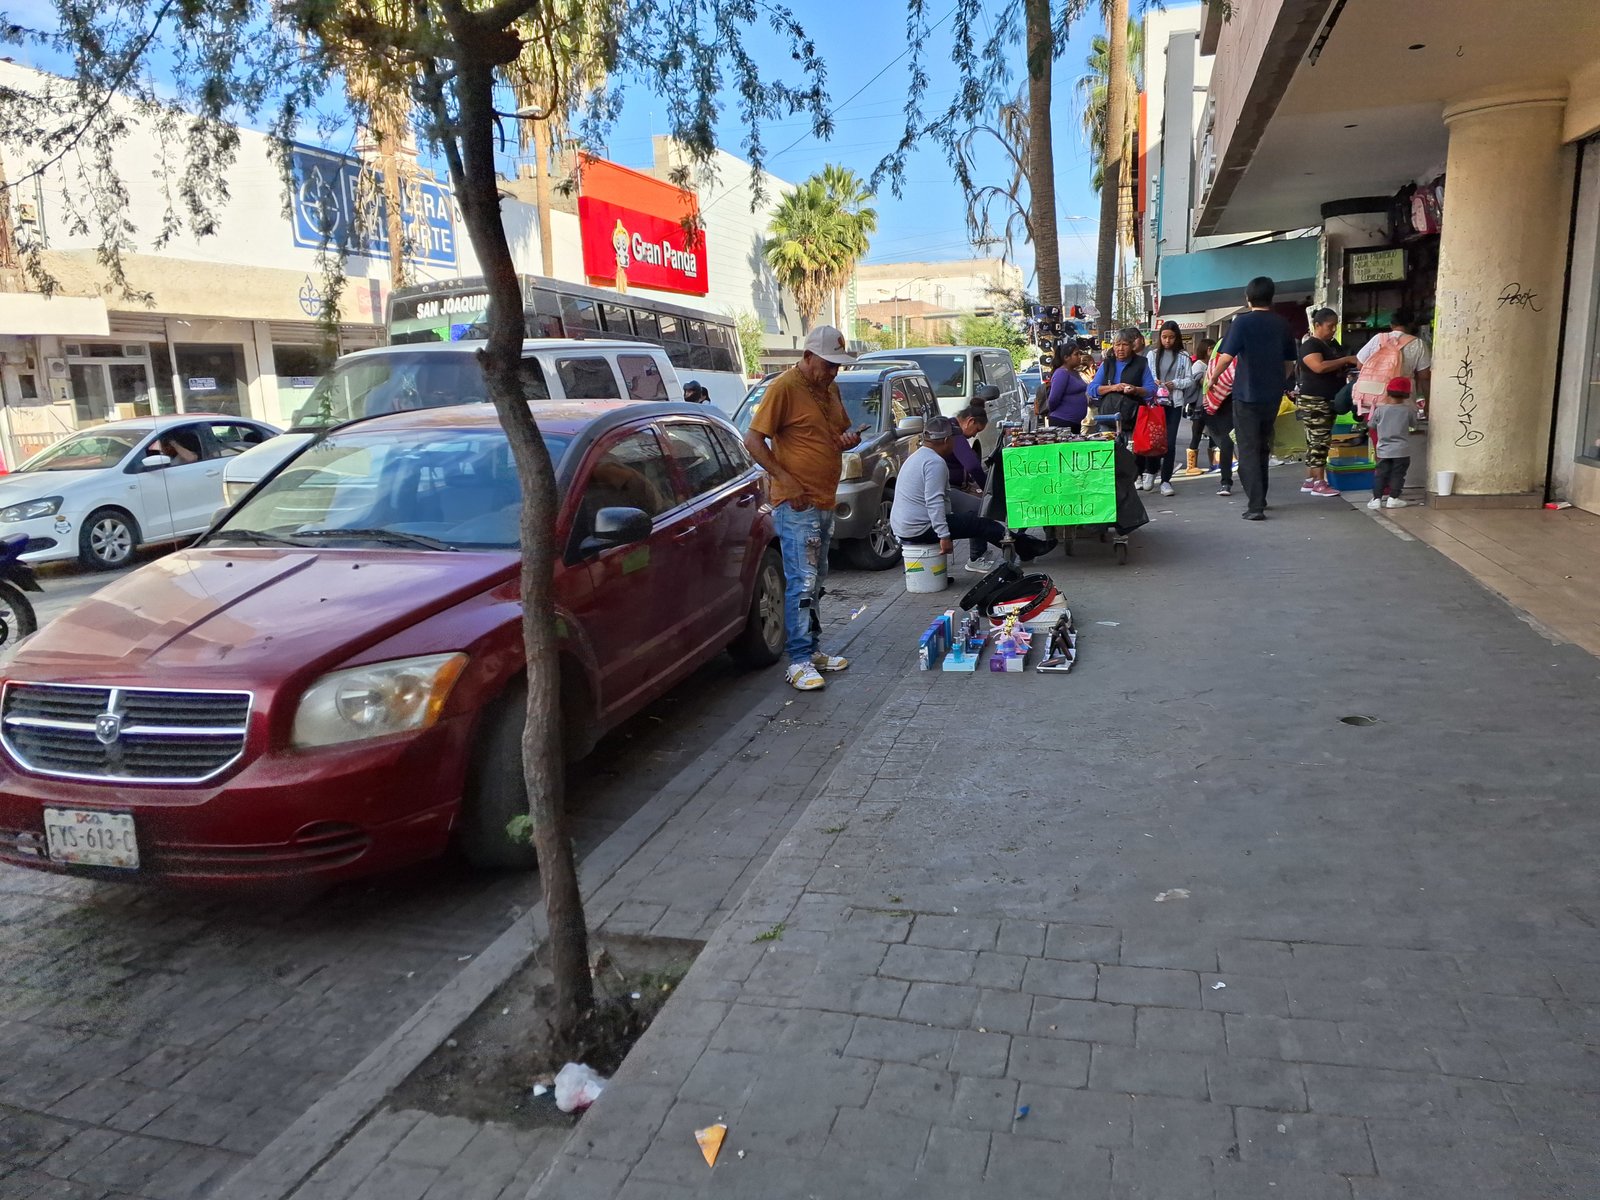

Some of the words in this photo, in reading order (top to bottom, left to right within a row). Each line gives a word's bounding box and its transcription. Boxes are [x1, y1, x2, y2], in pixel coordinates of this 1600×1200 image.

[632, 232, 661, 265] Gran
[663, 241, 697, 273] Panda
[416, 300, 439, 319] SAN
[440, 294, 490, 315] JOAQUIN
[1008, 453, 1049, 477] Rica
[1058, 449, 1114, 474] NUEZ
[1043, 479, 1062, 495] de
[1013, 495, 1094, 525] Temporada
